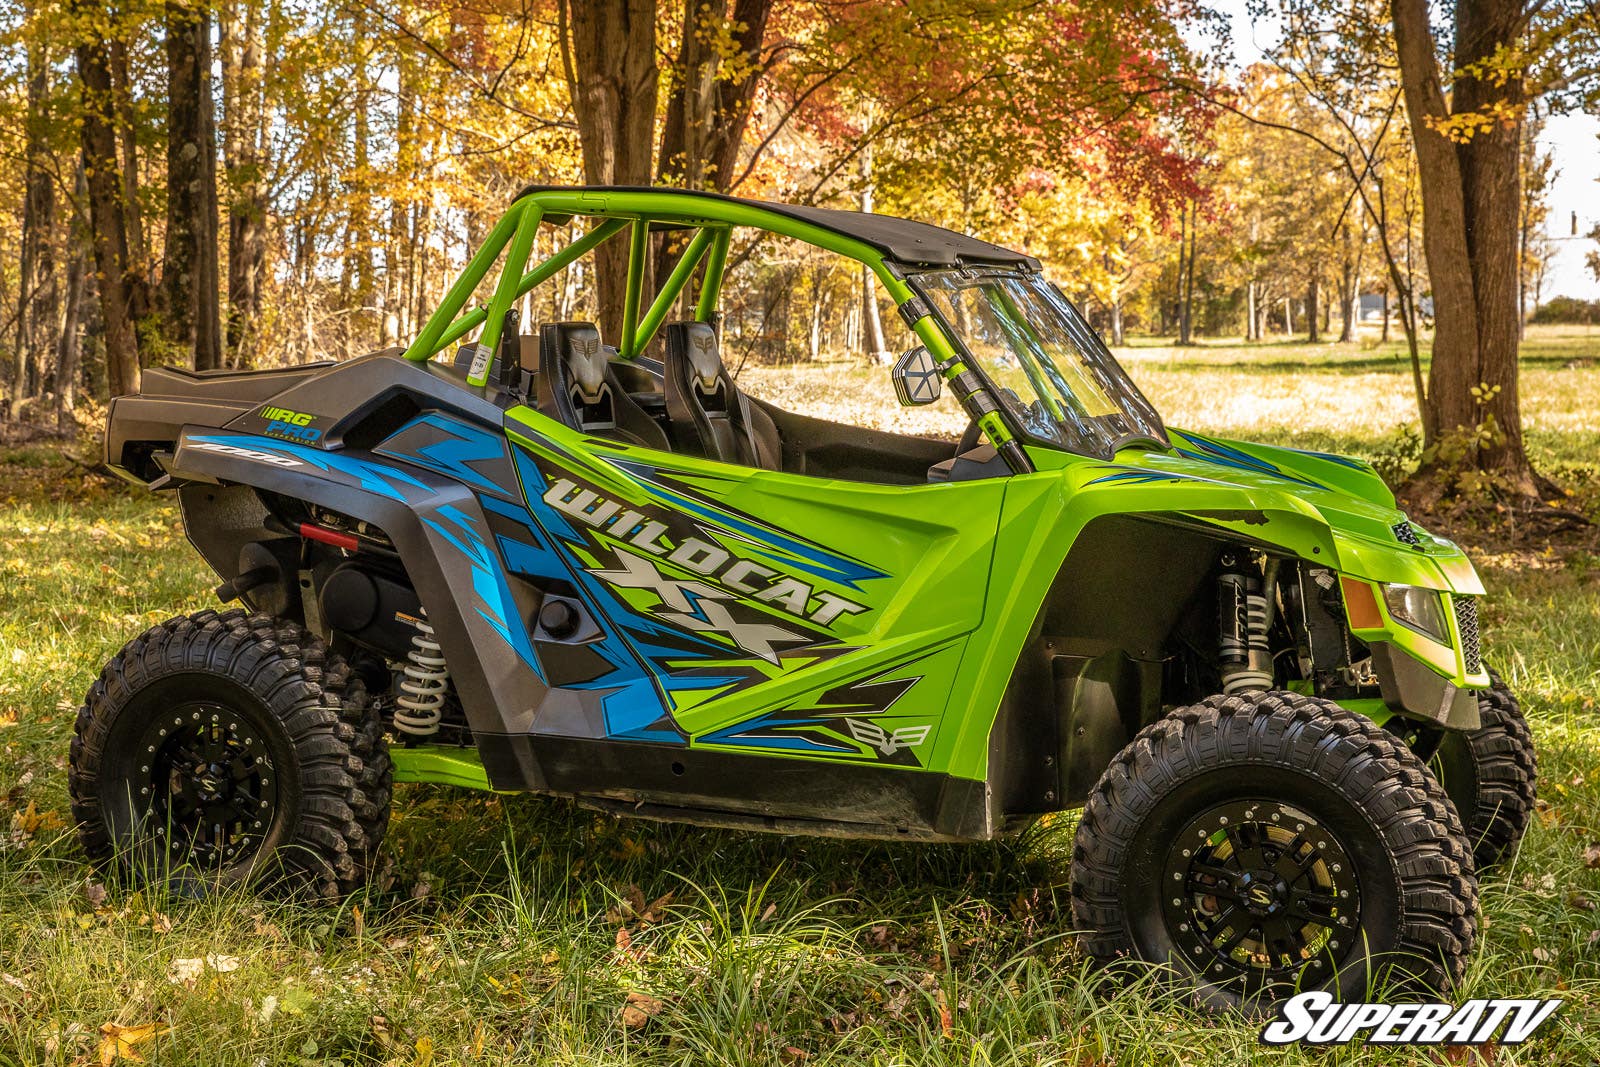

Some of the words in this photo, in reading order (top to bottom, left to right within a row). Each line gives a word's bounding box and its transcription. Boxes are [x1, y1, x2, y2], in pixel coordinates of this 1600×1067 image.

[266, 420, 322, 441] PRO
[542, 478, 873, 626] WILDCAT
[583, 545, 814, 666] XX
